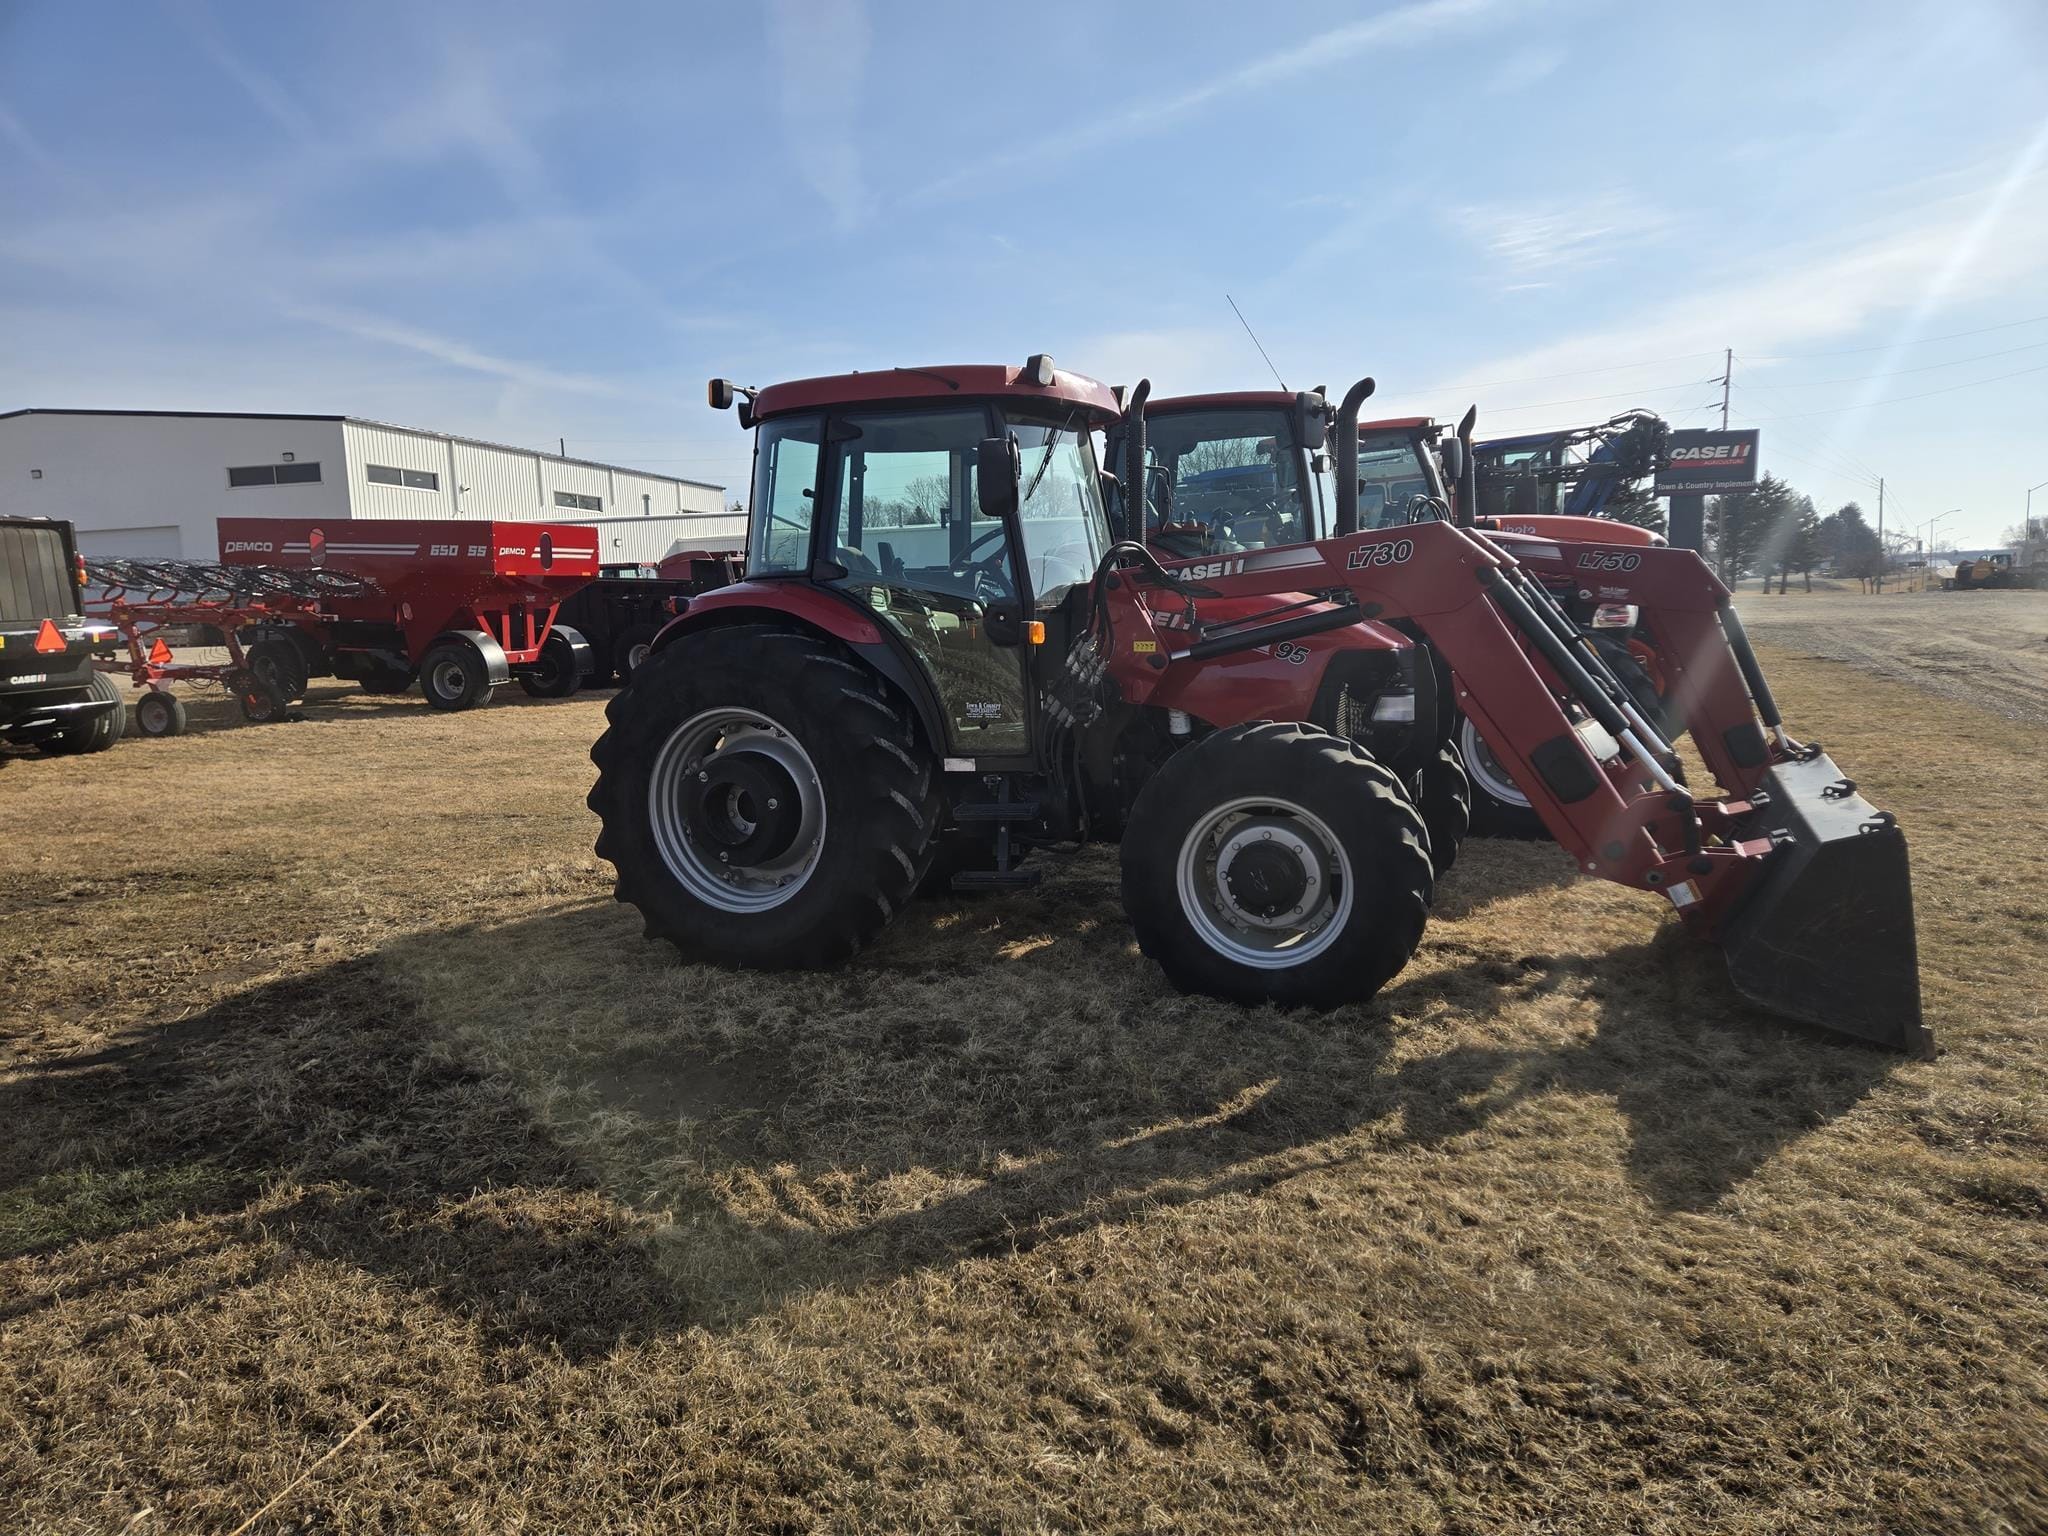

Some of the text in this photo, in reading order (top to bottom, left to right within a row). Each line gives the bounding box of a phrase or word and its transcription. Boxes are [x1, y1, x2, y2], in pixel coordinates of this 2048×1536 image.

[1671, 446, 1730, 460] CASE
[1685, 481, 1714, 490] Country
[1715, 480, 1755, 489] Implement
[224, 541, 273, 554] DEMCO
[430, 544, 459, 556] 650
[499, 547, 526, 556] DEMCO
[1347, 539, 1414, 570] L730
[1576, 551, 1641, 572] L750
[1274, 641, 1311, 665] 95
[10, 675, 37, 685] CASE
